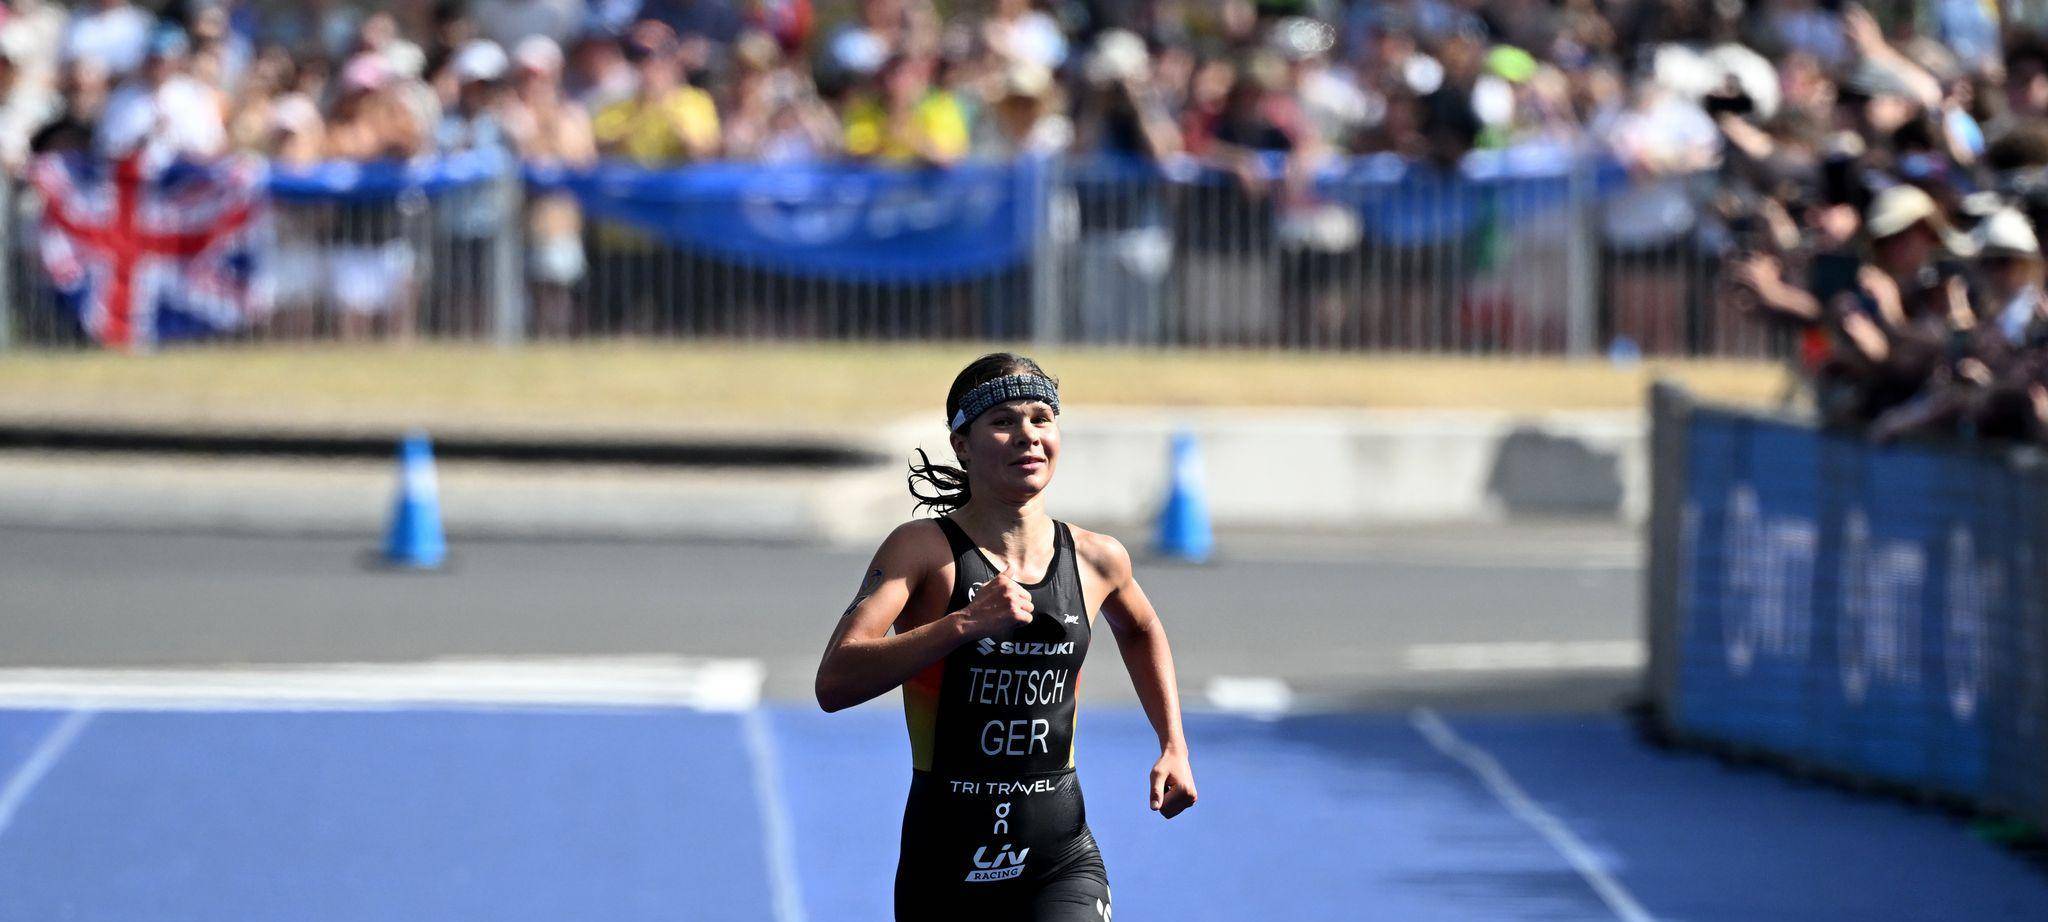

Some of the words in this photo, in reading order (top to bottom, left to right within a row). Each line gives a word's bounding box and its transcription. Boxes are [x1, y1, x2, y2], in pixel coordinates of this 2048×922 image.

[1000, 641, 1074, 655] SUZUKI
[969, 667, 1068, 706] TERTSCH
[981, 718, 1049, 756] GER
[950, 781, 979, 794] TRI
[986, 779, 1055, 795] TRAVEL
[974, 868, 1019, 880] RACING
